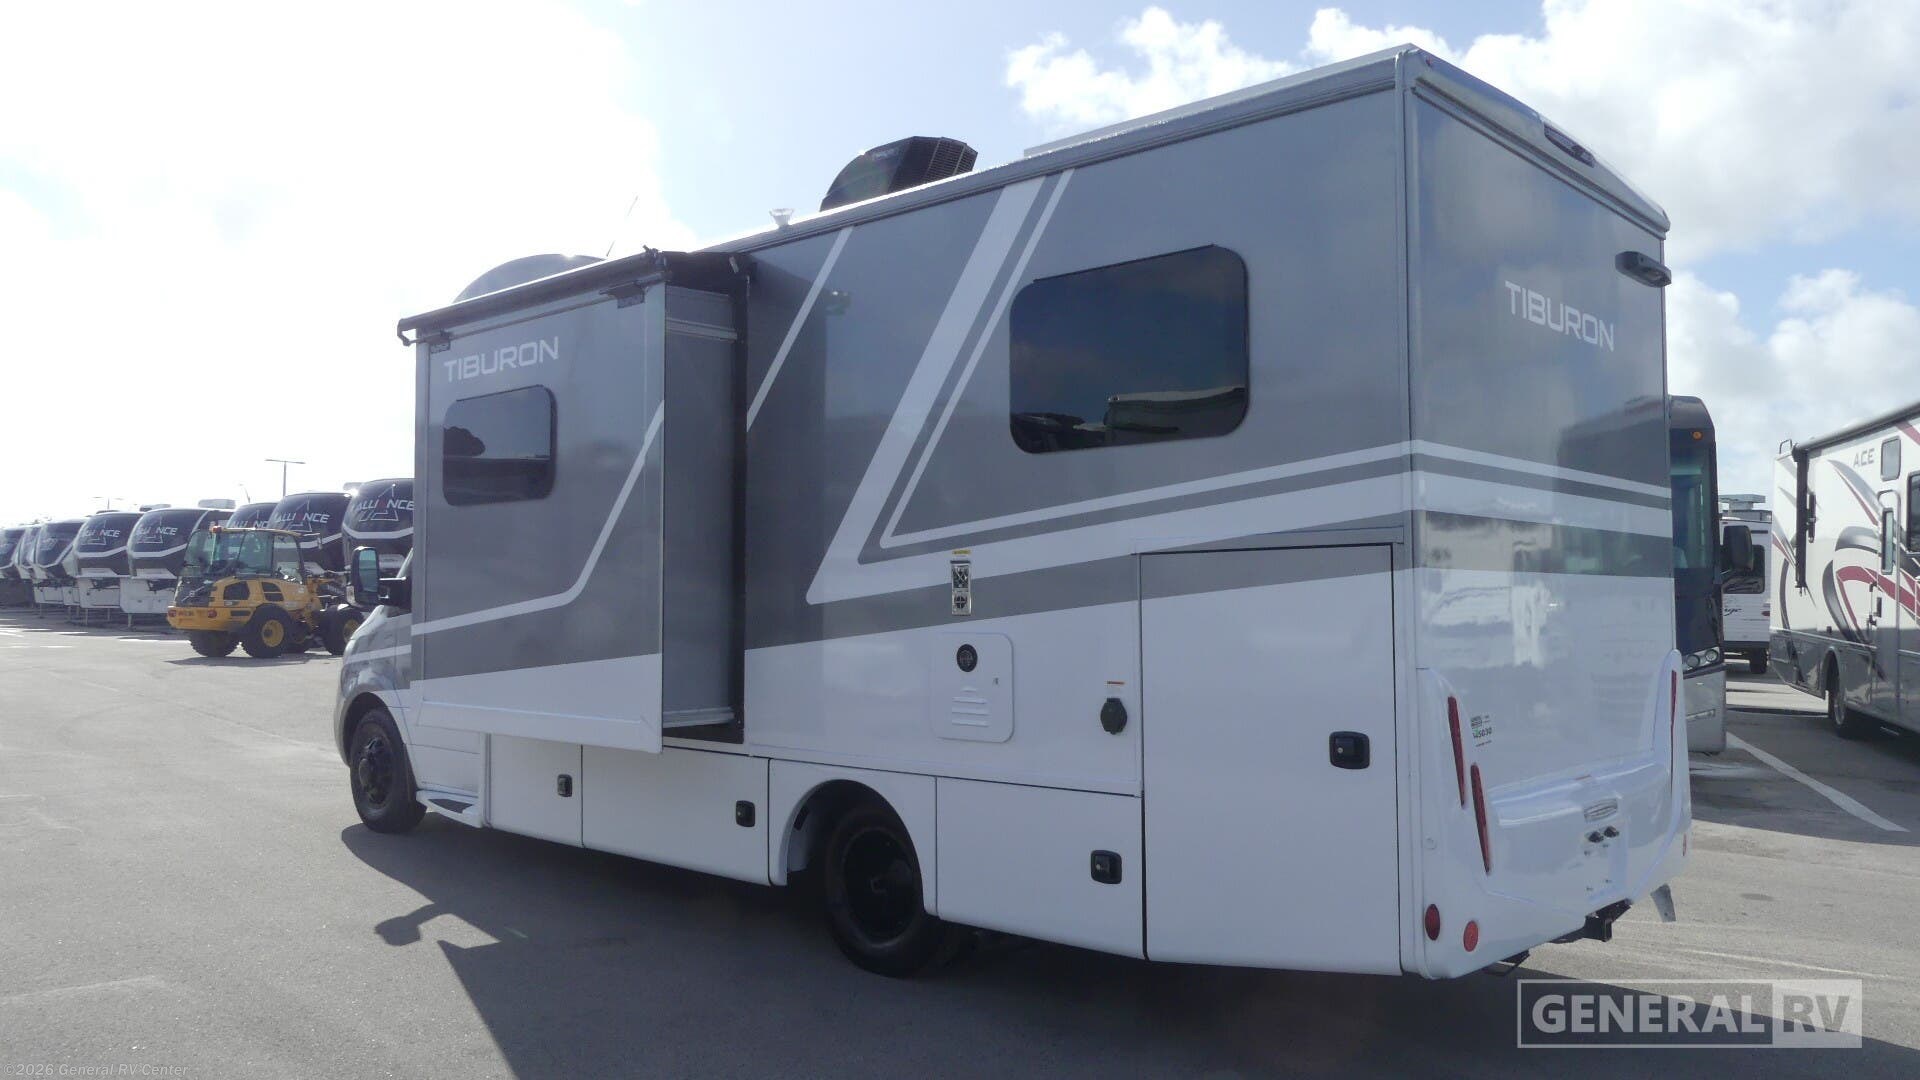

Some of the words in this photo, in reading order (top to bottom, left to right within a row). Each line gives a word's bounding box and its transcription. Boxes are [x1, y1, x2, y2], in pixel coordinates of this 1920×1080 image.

[1504, 279, 1615, 353] TIBURON
[443, 336, 560, 382] TIBURON
[1853, 447, 1876, 468] ACE
